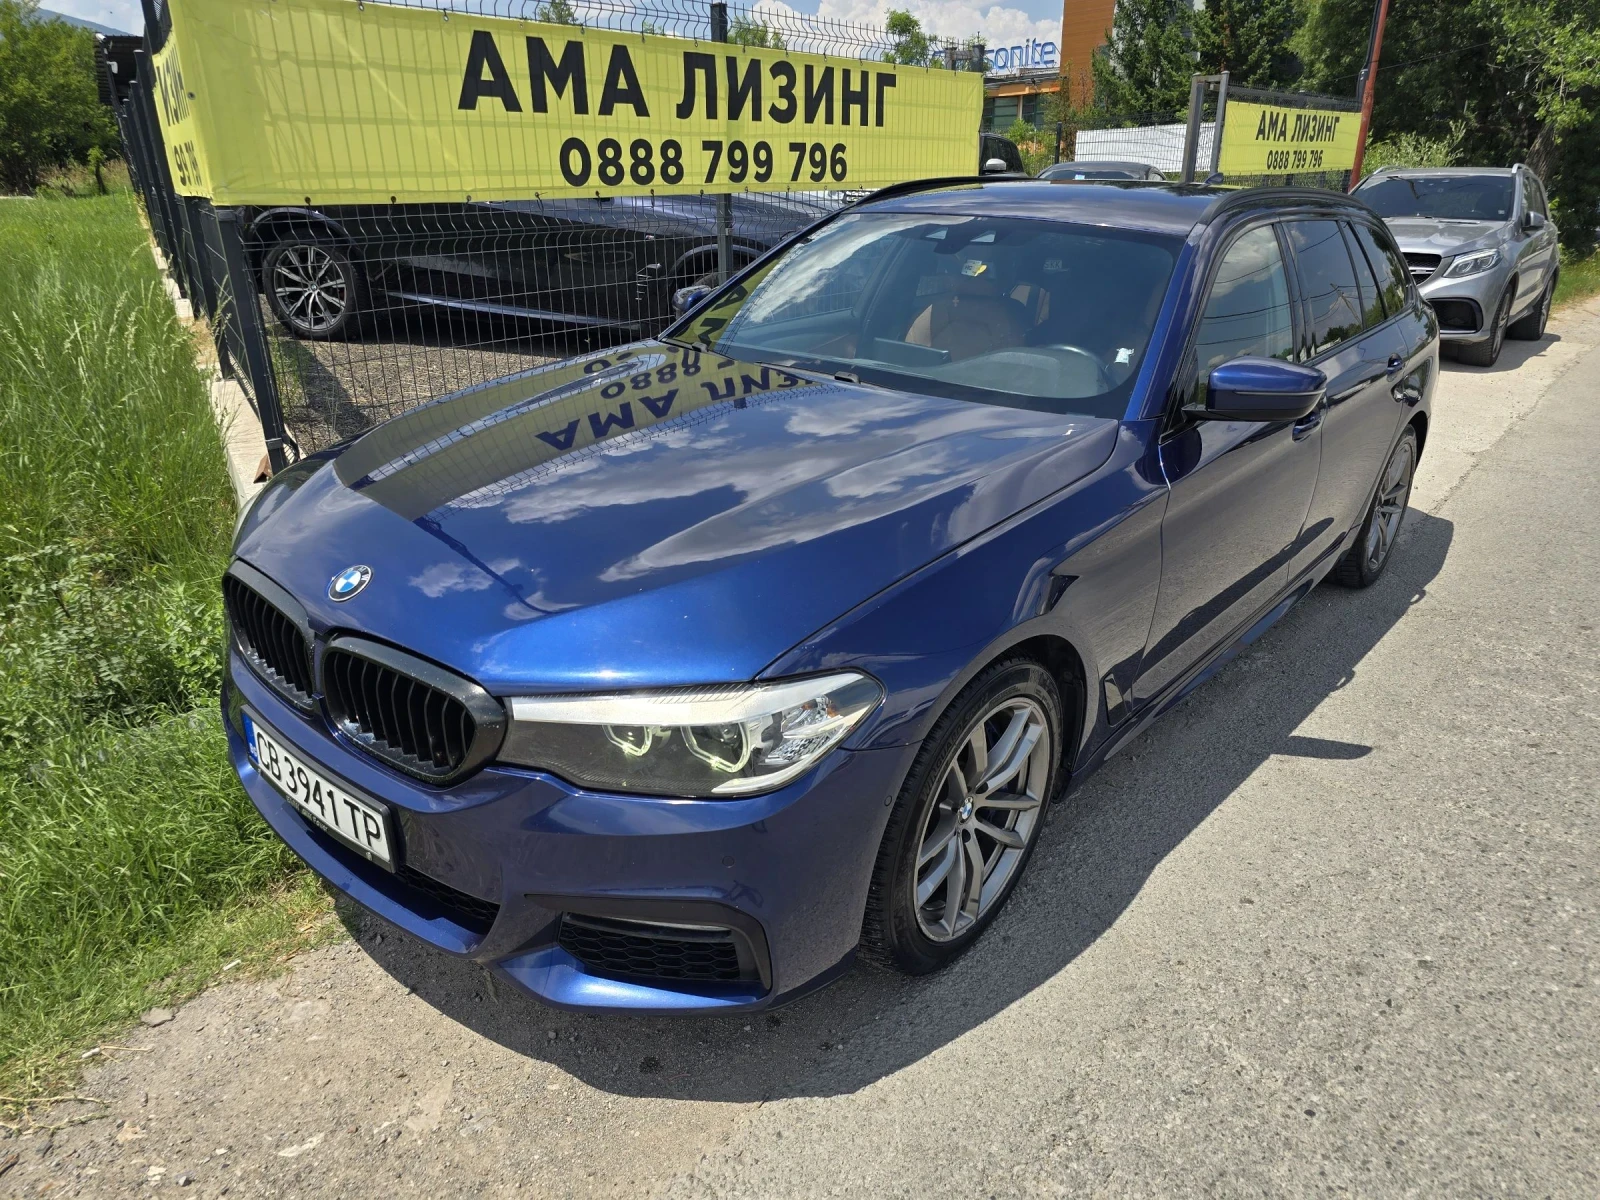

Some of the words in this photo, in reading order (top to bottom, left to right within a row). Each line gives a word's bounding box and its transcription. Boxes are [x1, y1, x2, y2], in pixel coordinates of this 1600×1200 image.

[457, 30, 650, 118] АМА
[676, 51, 897, 128] ЛИЗИНГ
[1256, 110, 1287, 142] АМА
[1290, 113, 1340, 143] ЛИЗИНГ
[559, 137, 684, 187] 0888
[701, 140, 774, 184] 799
[788, 142, 848, 183] 796
[1266, 150, 1290, 170] 0888
[1291, 150, 1308, 169] 799
[1308, 150, 1324, 168] 796
[284, 755, 339, 828] 3941
